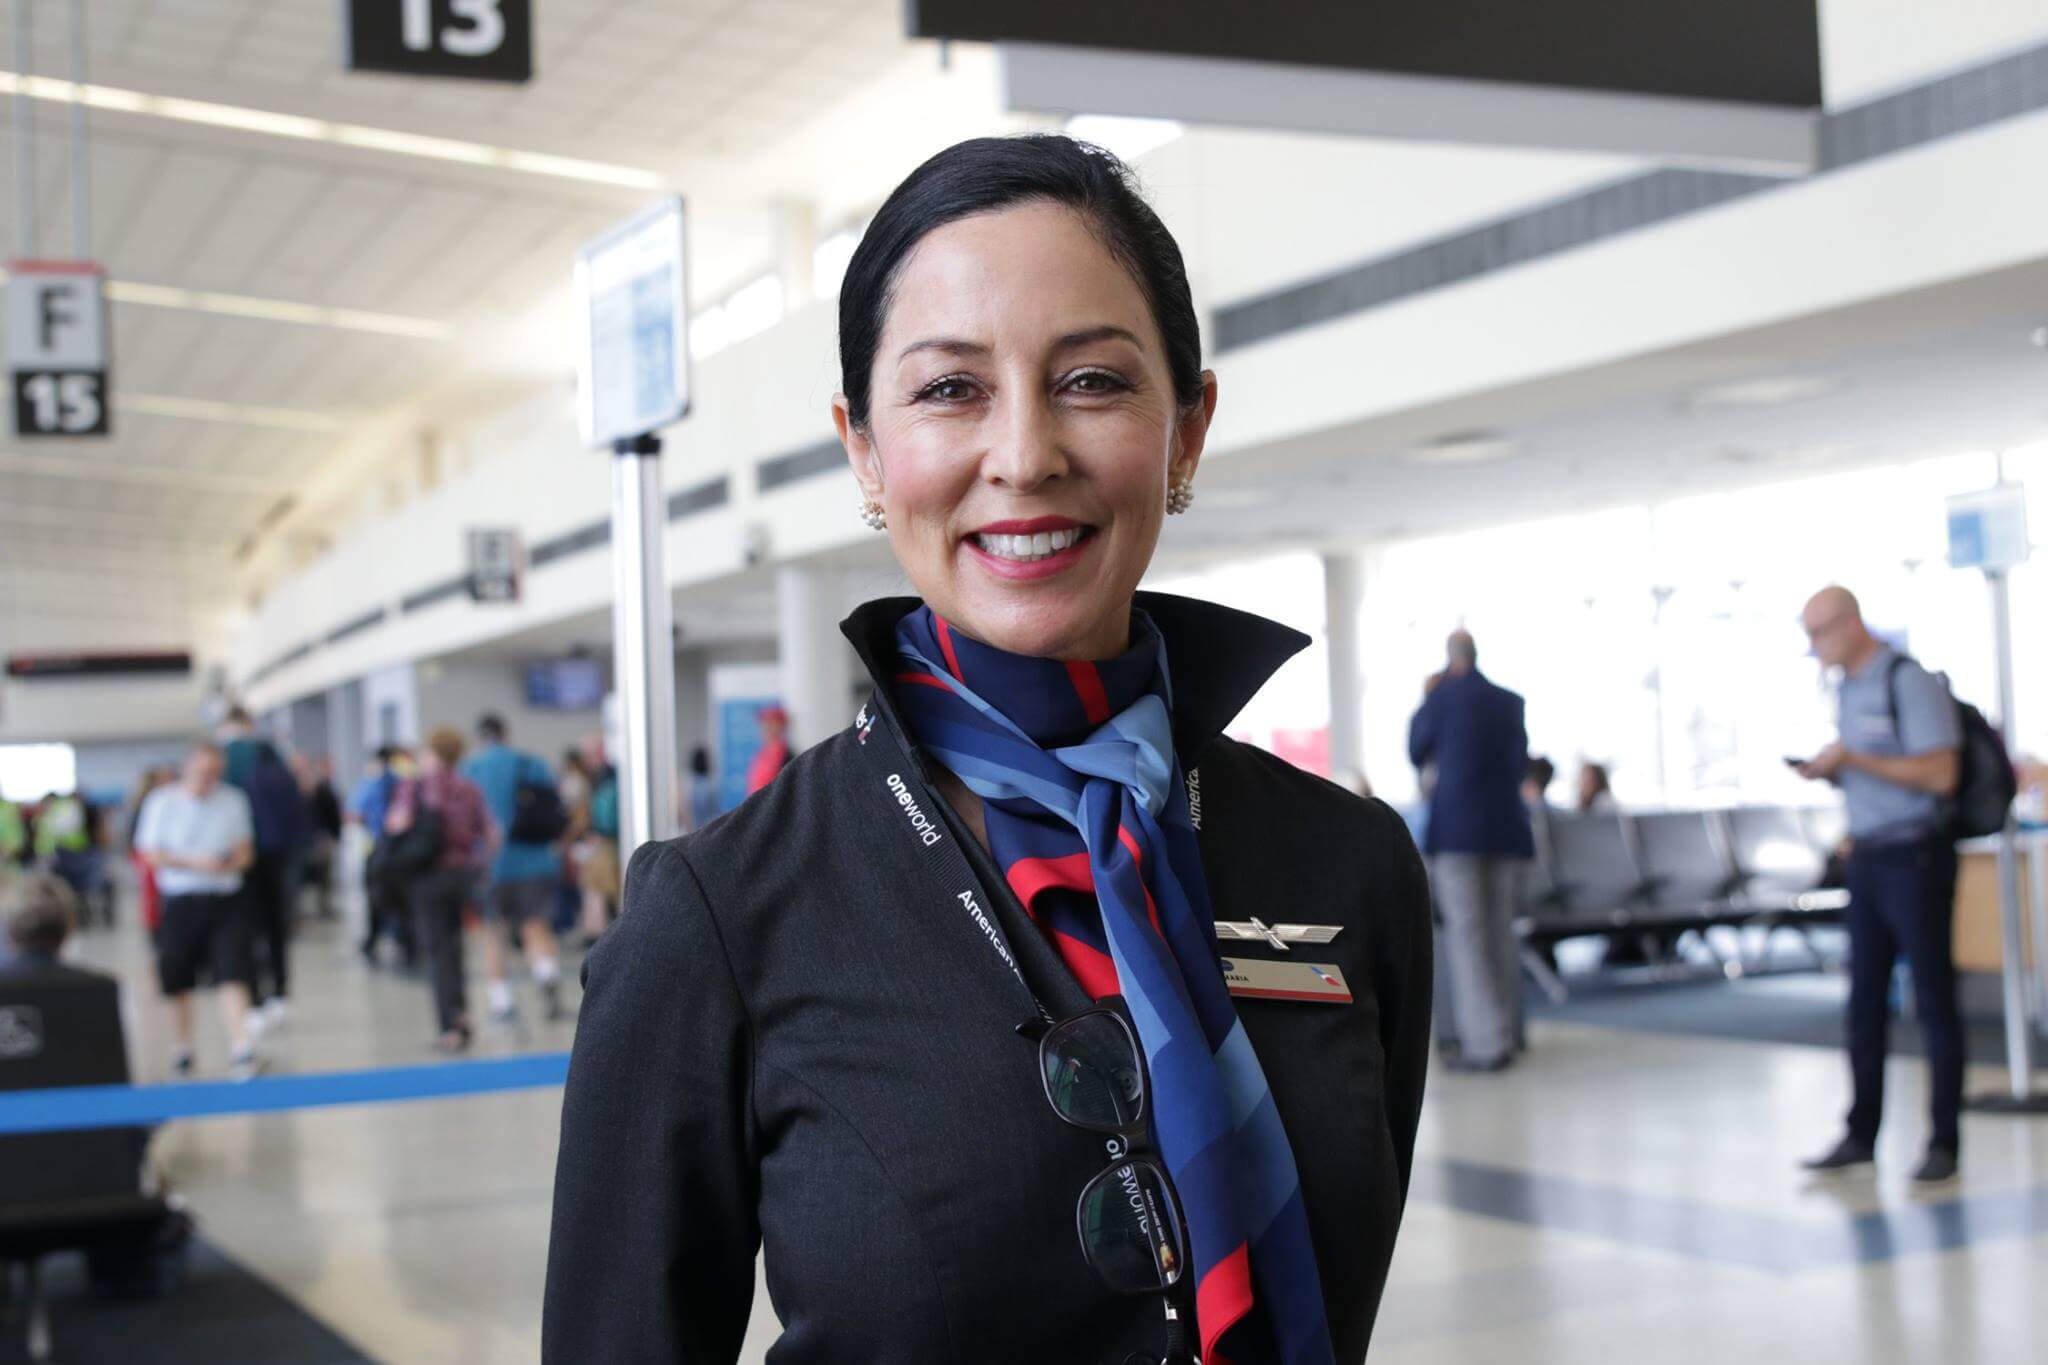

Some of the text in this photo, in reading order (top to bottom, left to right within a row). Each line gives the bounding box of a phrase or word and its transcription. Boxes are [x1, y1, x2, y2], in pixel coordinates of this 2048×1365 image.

[39, 286, 79, 350] F
[24, 374, 100, 433] 15
[886, 773, 942, 846] oneworld
[1185, 767, 1202, 830] America
[957, 889, 1014, 968] American
